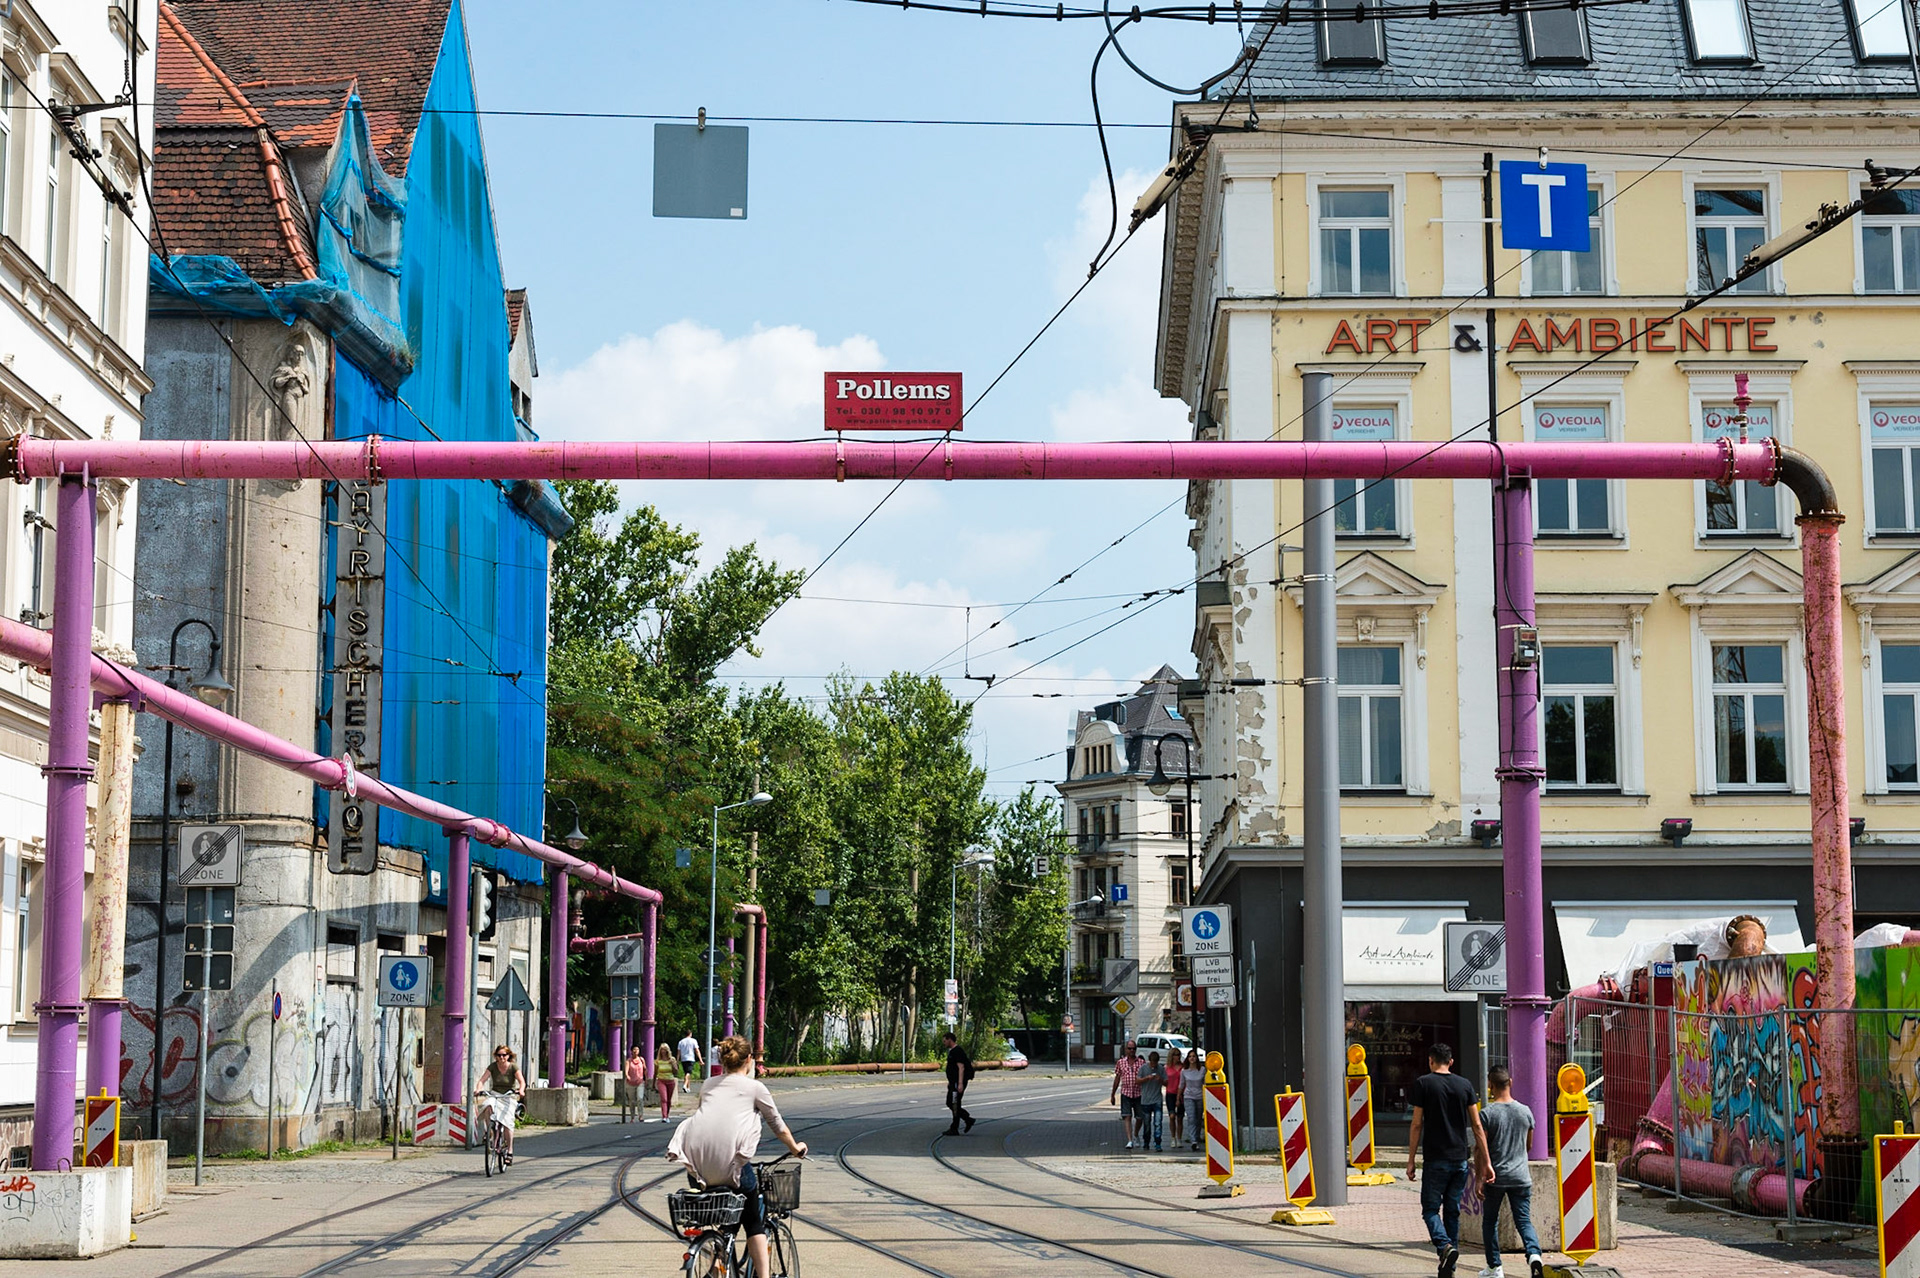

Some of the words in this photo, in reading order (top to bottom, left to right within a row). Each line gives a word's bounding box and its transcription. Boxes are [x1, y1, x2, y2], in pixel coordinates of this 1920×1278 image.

[1521, 173, 1566, 238] T
[1325, 318, 1431, 354] ART
[1453, 324, 1483, 353] &
[1506, 317, 1778, 352] AMBIENTE
[835, 379, 952, 400] Pollems
[836, 407, 856, 415] Tel.
[861, 407, 880, 415] 030
[893, 407, 906, 415] 98
[911, 407, 924, 415] 10
[928, 407, 940, 415] 97
[1345, 417, 1391, 427] VEOLIA
[1557, 416, 1602, 425] VEOLIA
[1037, 858, 1047, 873] E
[1115, 886, 1124, 899] T
[1195, 941, 1220, 951] ZONE
[1205, 958, 1220, 967] LVB
[1207, 975, 1221, 983] frei
[390, 993, 416, 1003] ZONE
